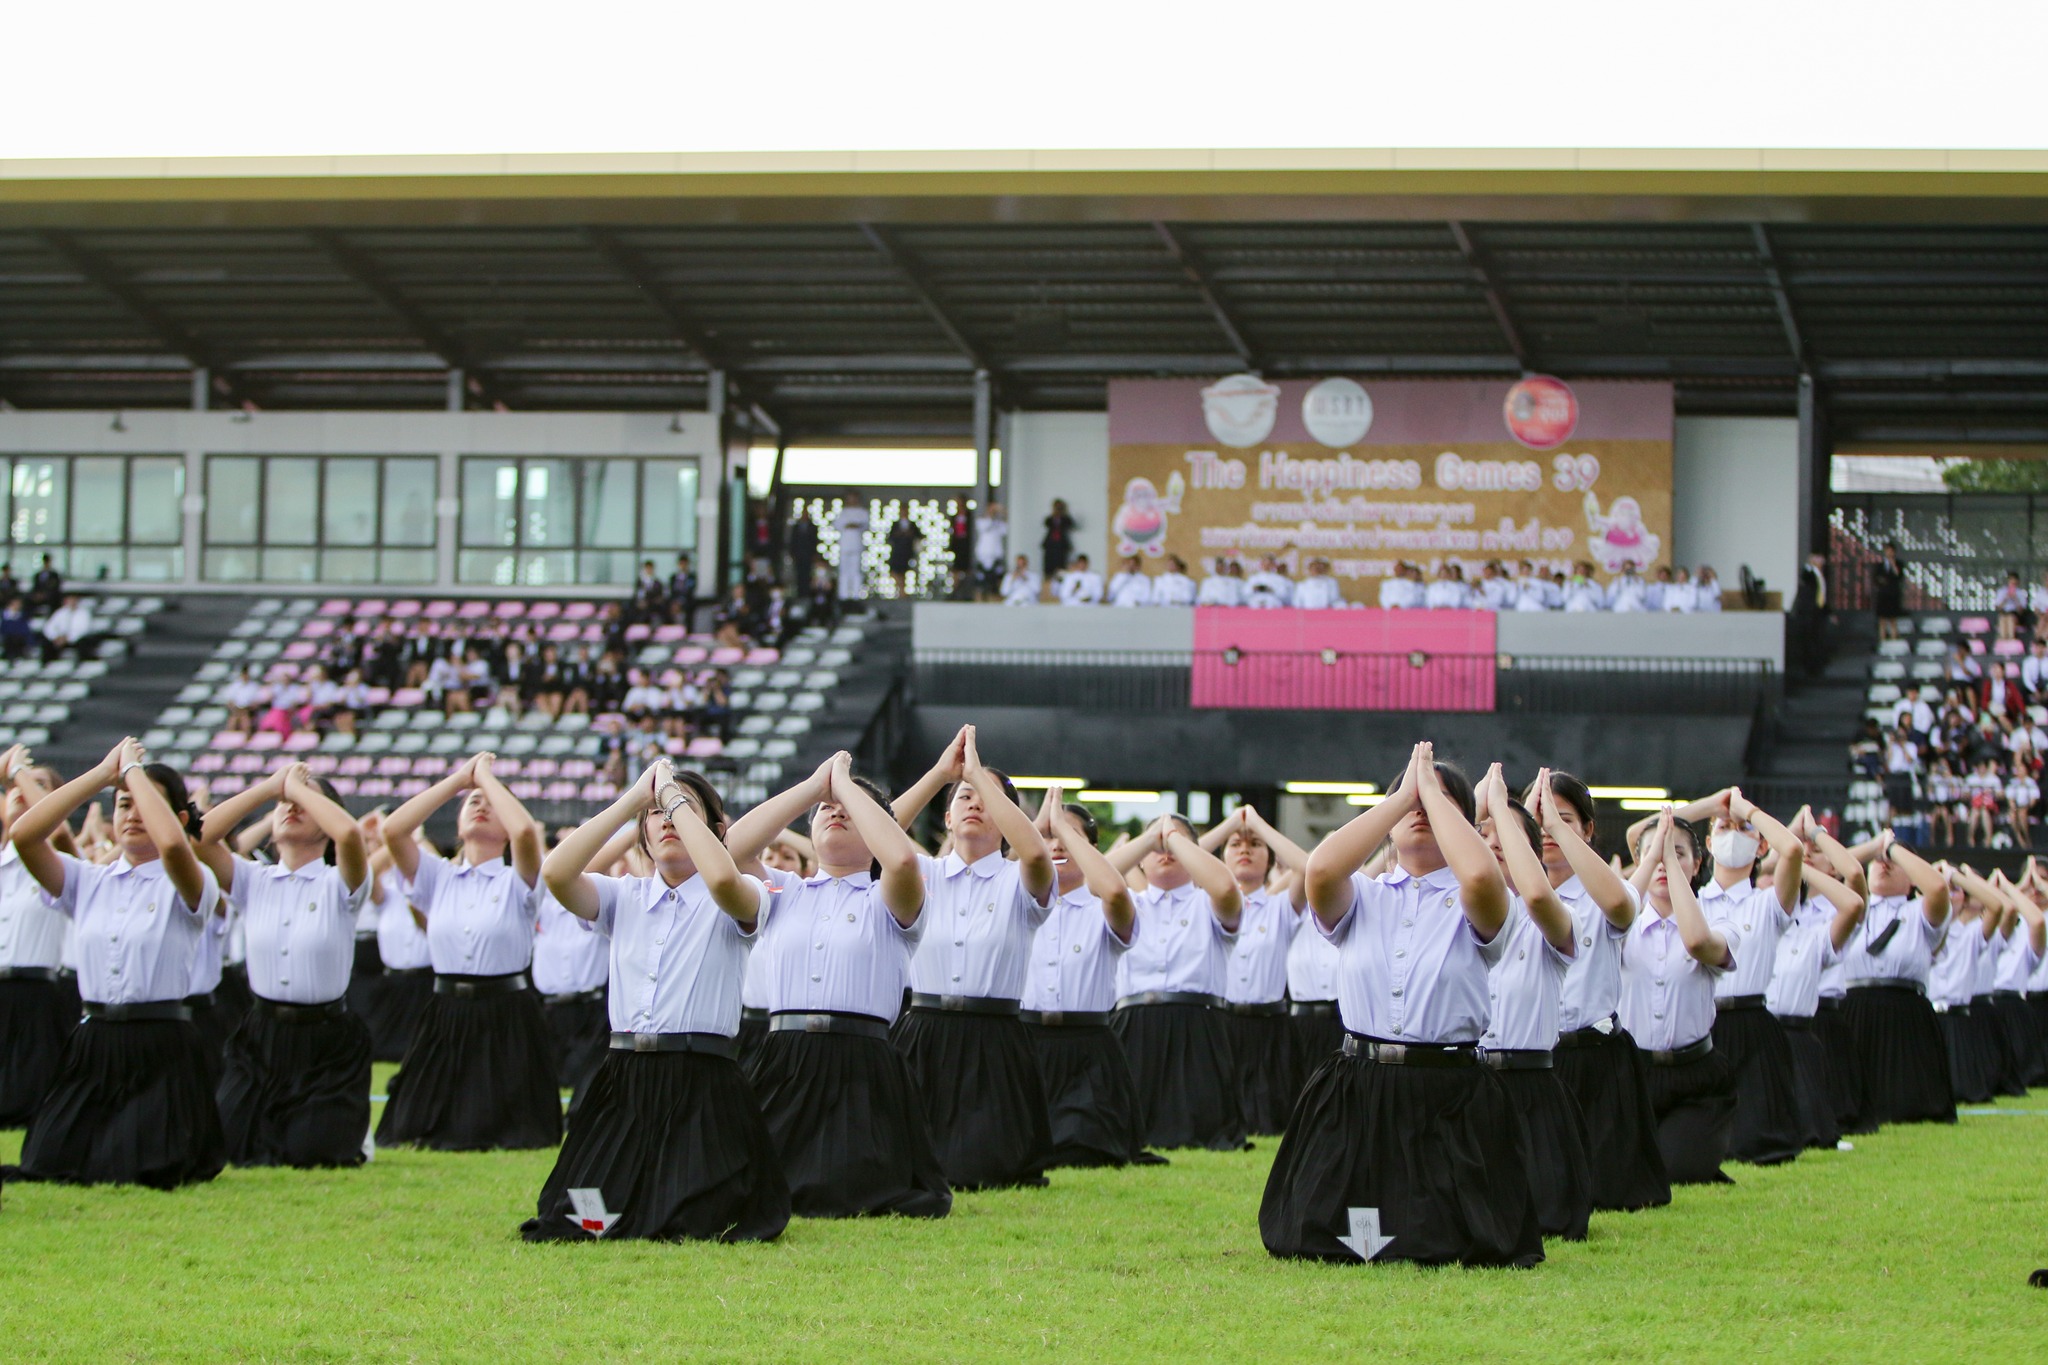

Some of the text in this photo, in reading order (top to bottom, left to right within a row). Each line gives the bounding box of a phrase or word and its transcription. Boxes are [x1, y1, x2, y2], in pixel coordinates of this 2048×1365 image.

[1185, 451, 1600, 497] The Happiness Games 39
